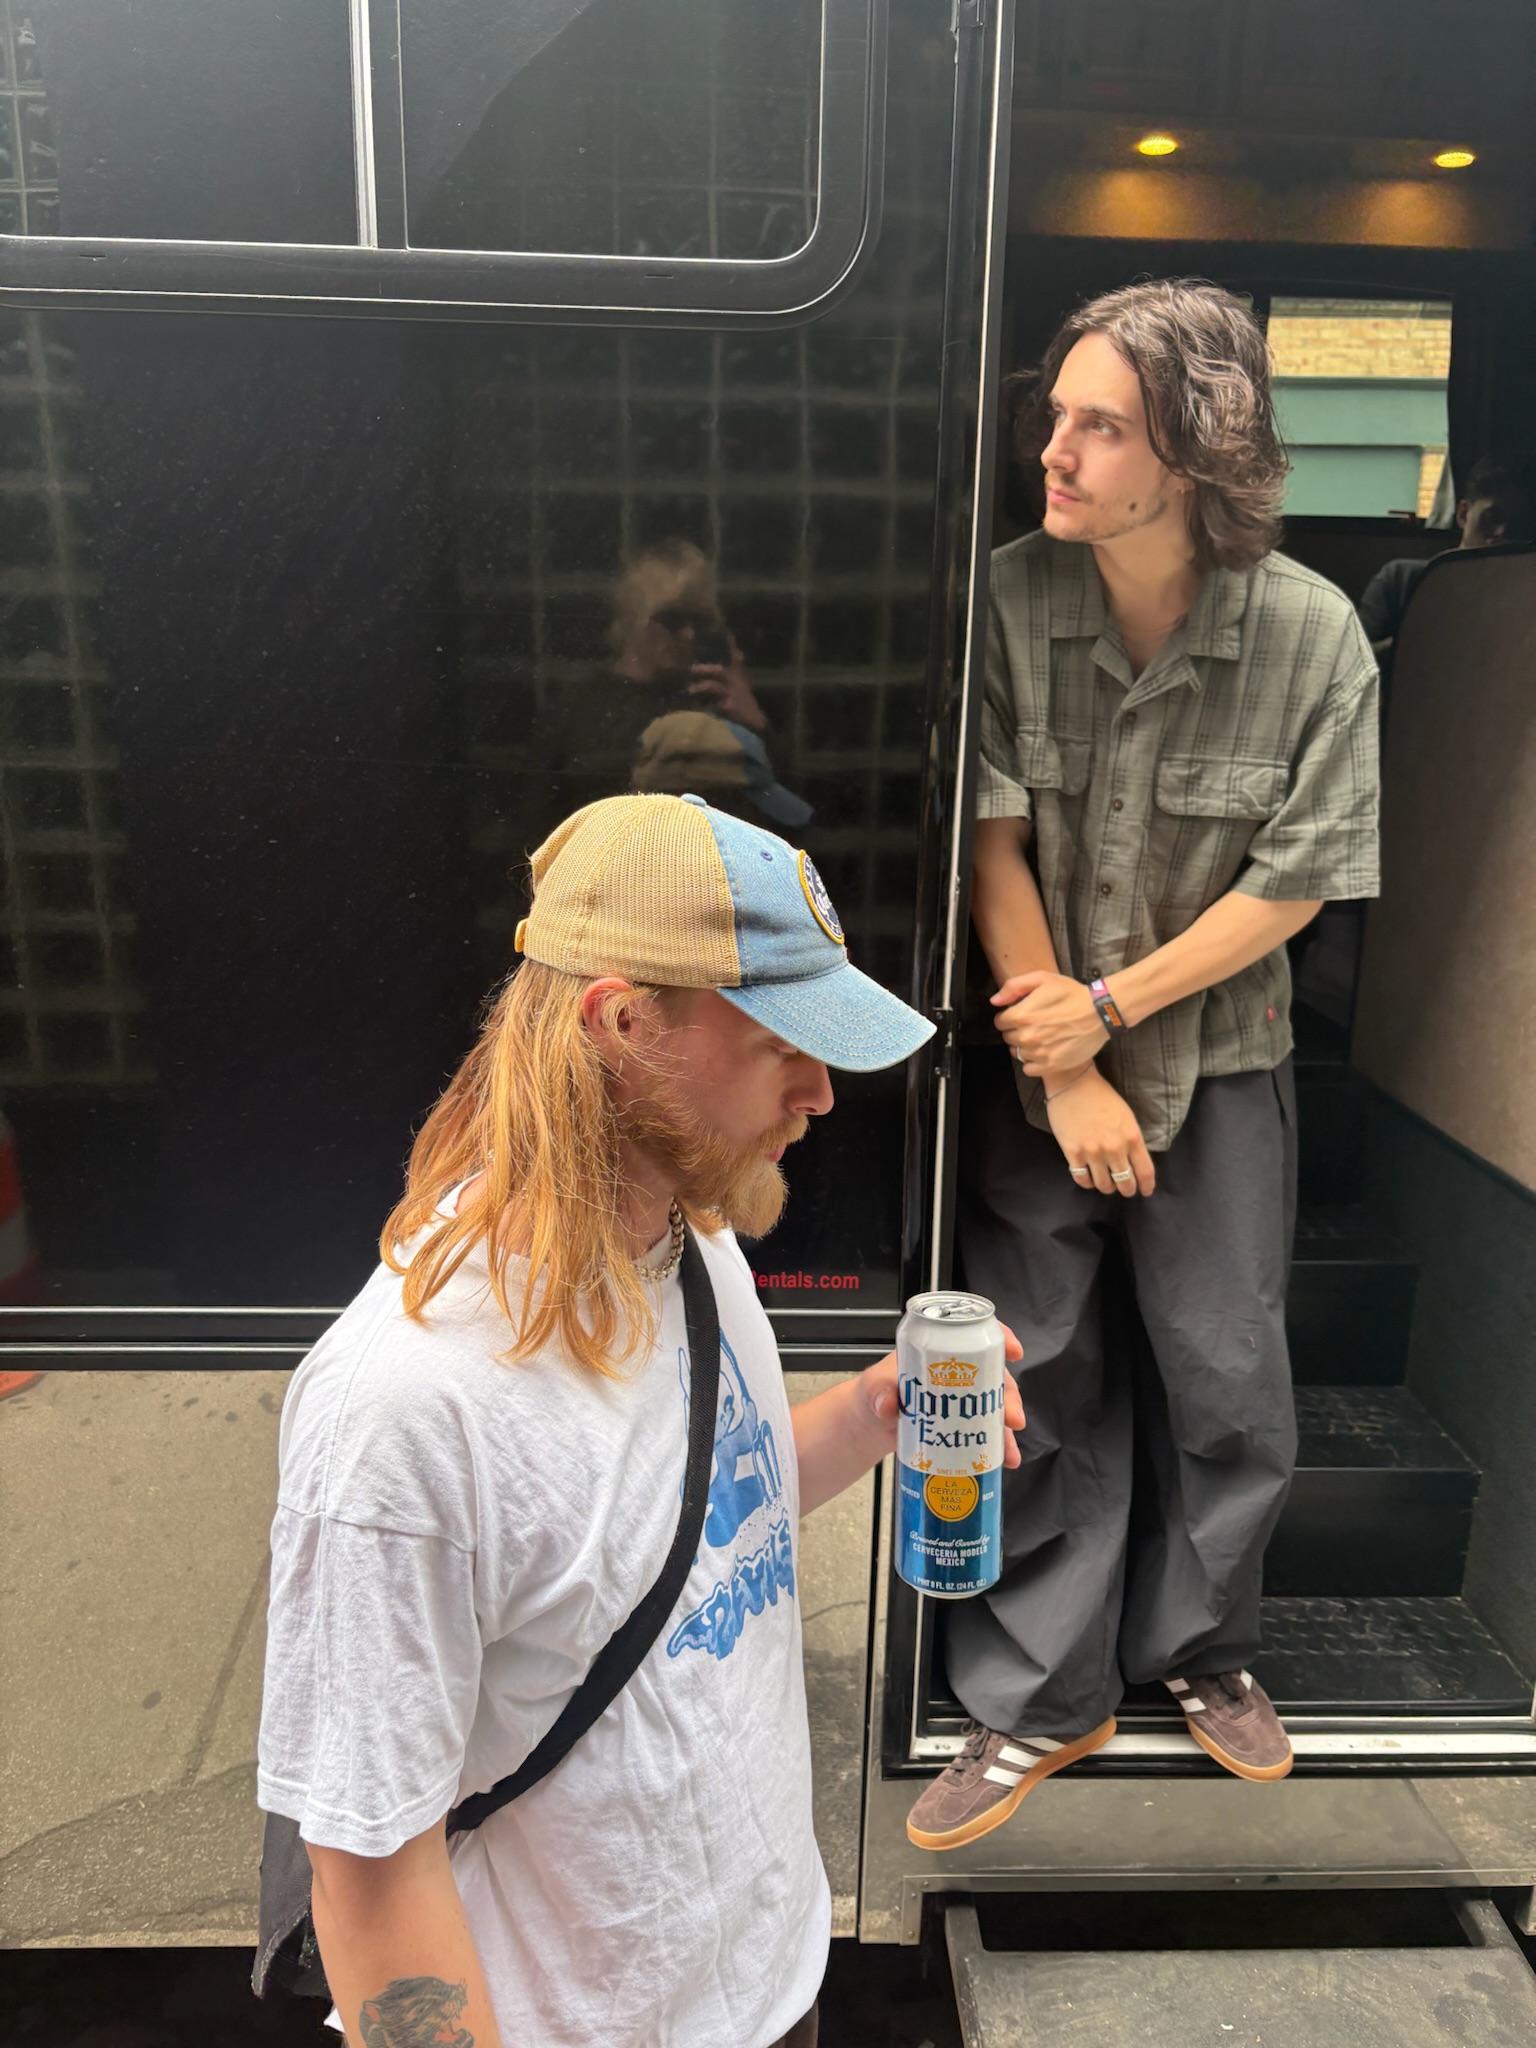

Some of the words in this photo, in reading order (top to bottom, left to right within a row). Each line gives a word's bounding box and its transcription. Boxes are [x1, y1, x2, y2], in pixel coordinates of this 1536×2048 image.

[919, 1418, 987, 1448] Extra
[930, 1486, 973, 1496] CERVEZA
[940, 1504, 961, 1512] FINA
[910, 1530, 939, 1545] Brewed
[938, 1538, 955, 1547] and
[912, 1543, 958, 1558] CERVECERIA
[959, 1545, 987, 1558] MODELO
[936, 1557, 965, 1567] MEXICO
